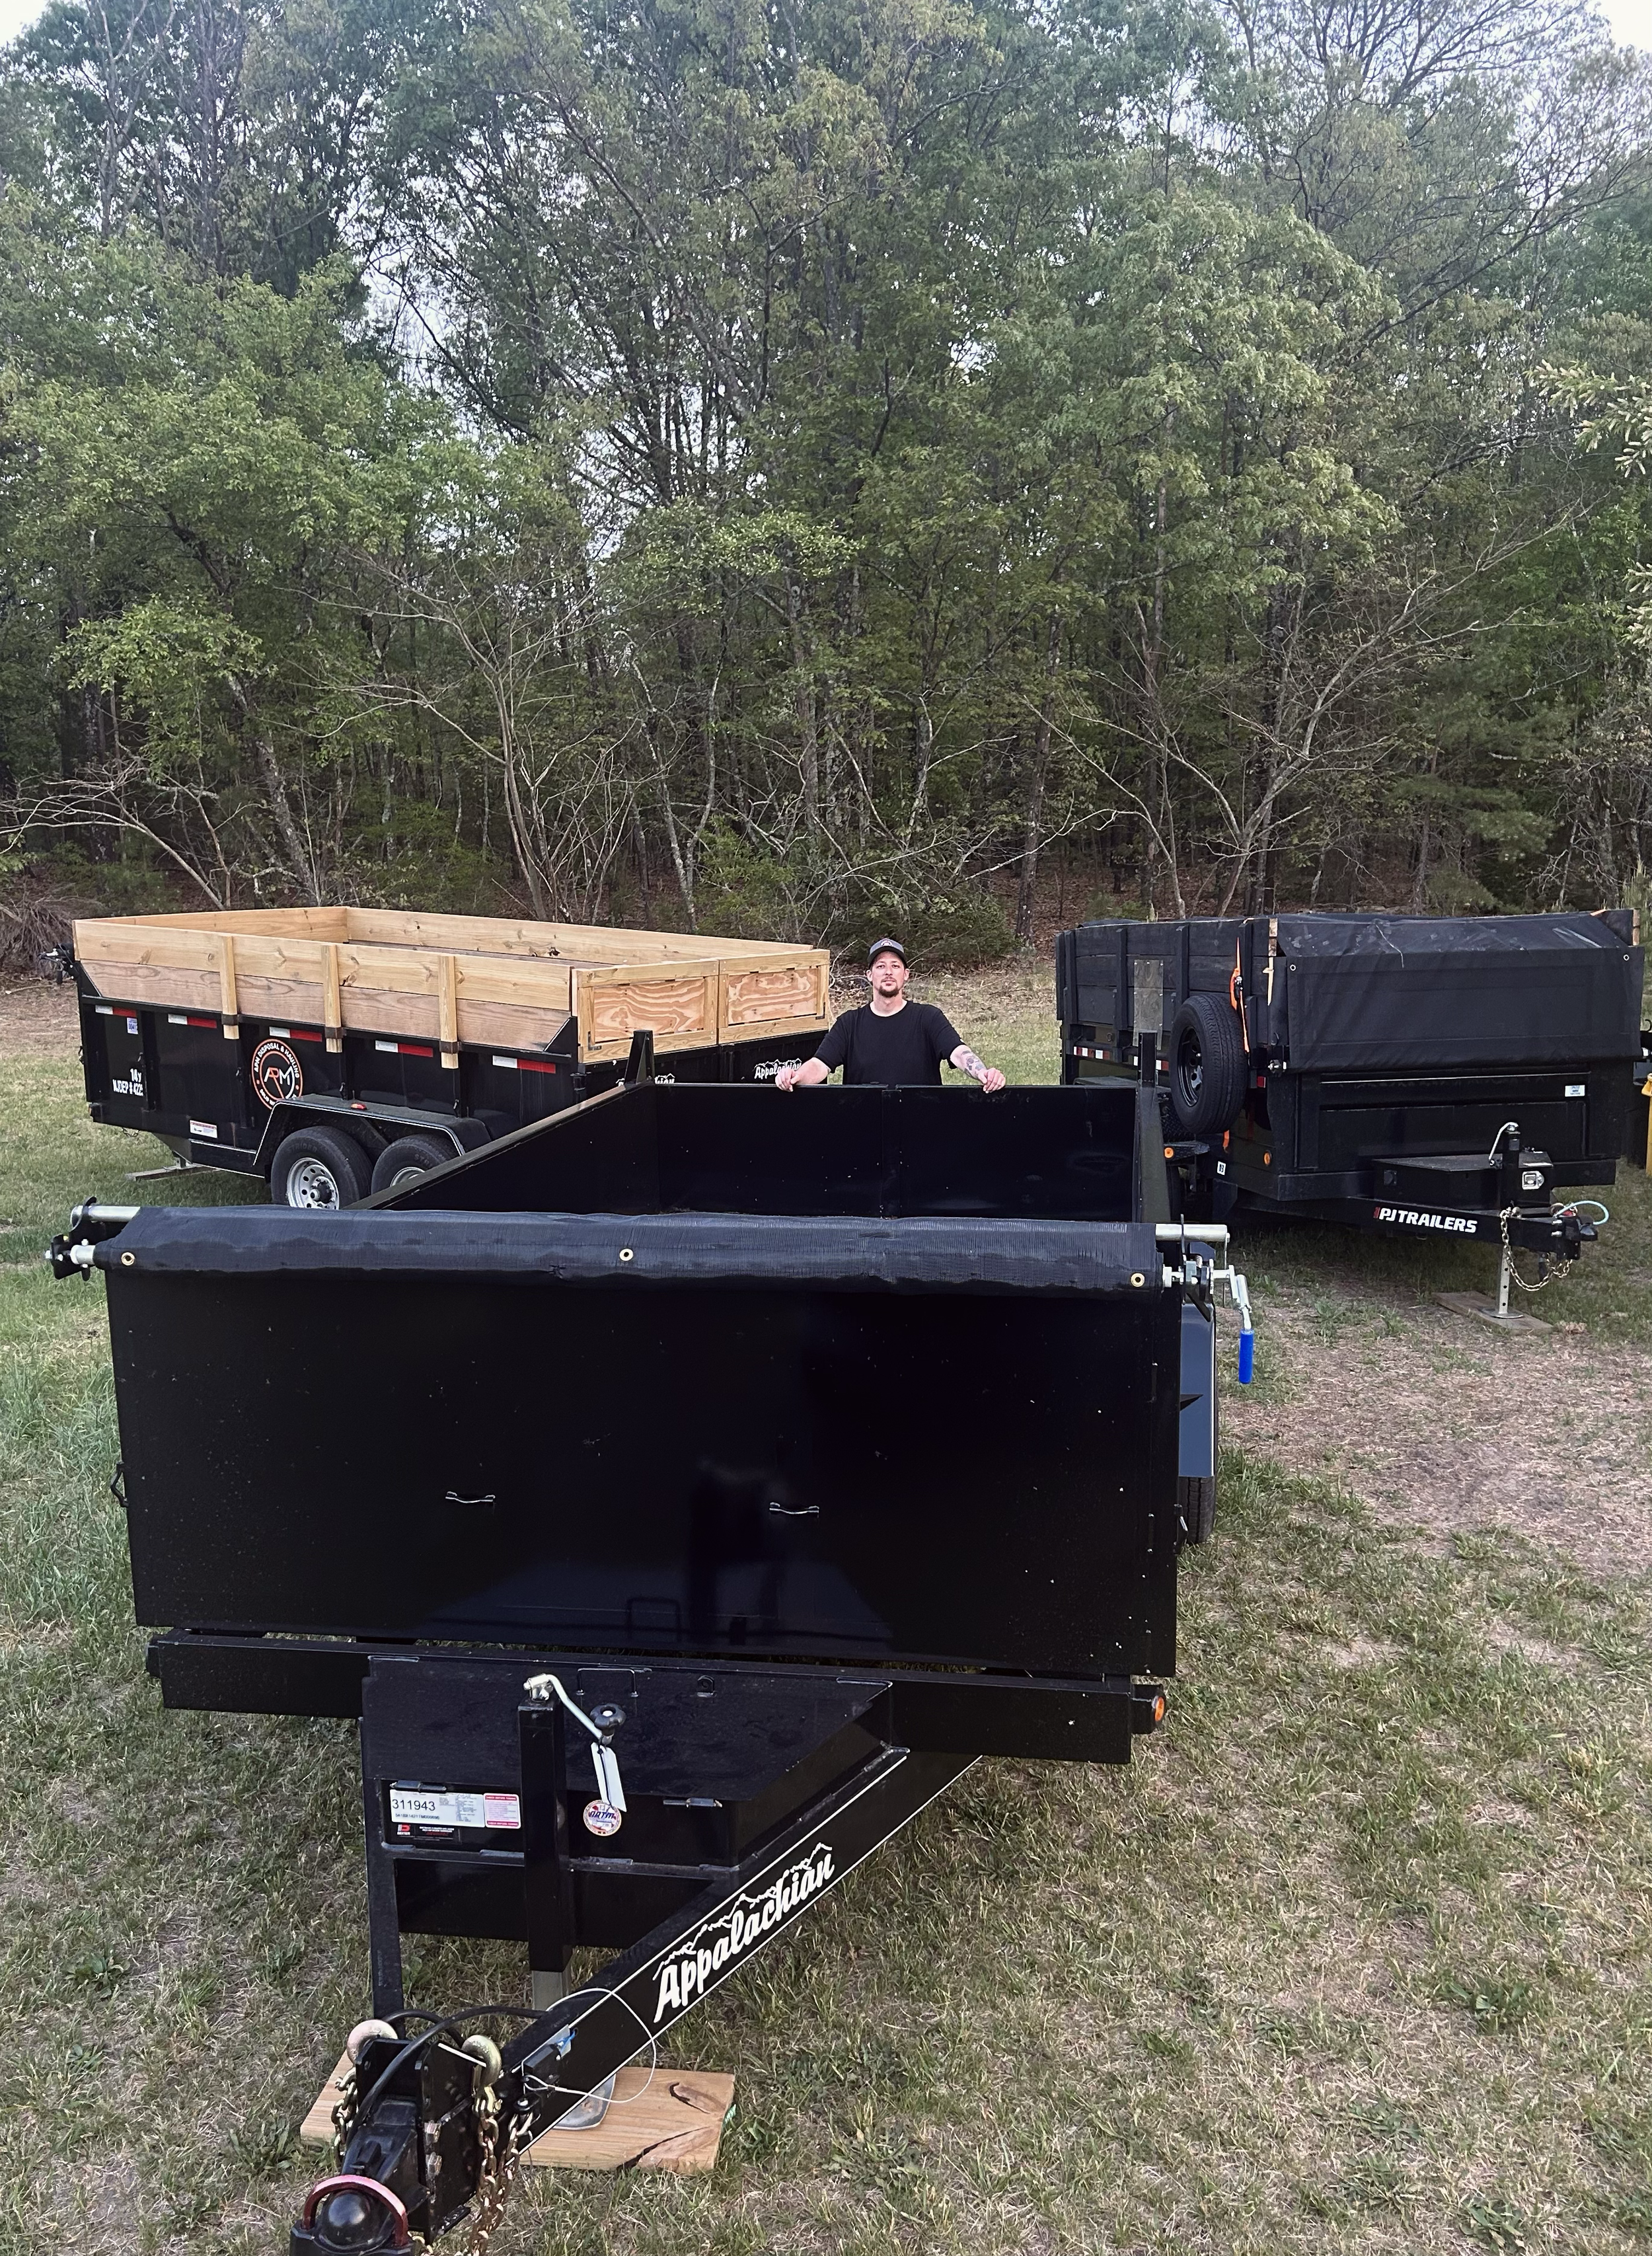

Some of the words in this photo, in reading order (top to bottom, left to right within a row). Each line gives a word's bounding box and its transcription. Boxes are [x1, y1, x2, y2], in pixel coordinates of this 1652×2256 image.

[258, 1043, 280, 1057] DISPOSAL
[284, 1049, 300, 1078] HAULING
[1398, 1210, 1478, 1233] TRAILERS
[392, 1799, 436, 1811] 311943
[654, 1853, 835, 2023] Appalachian
